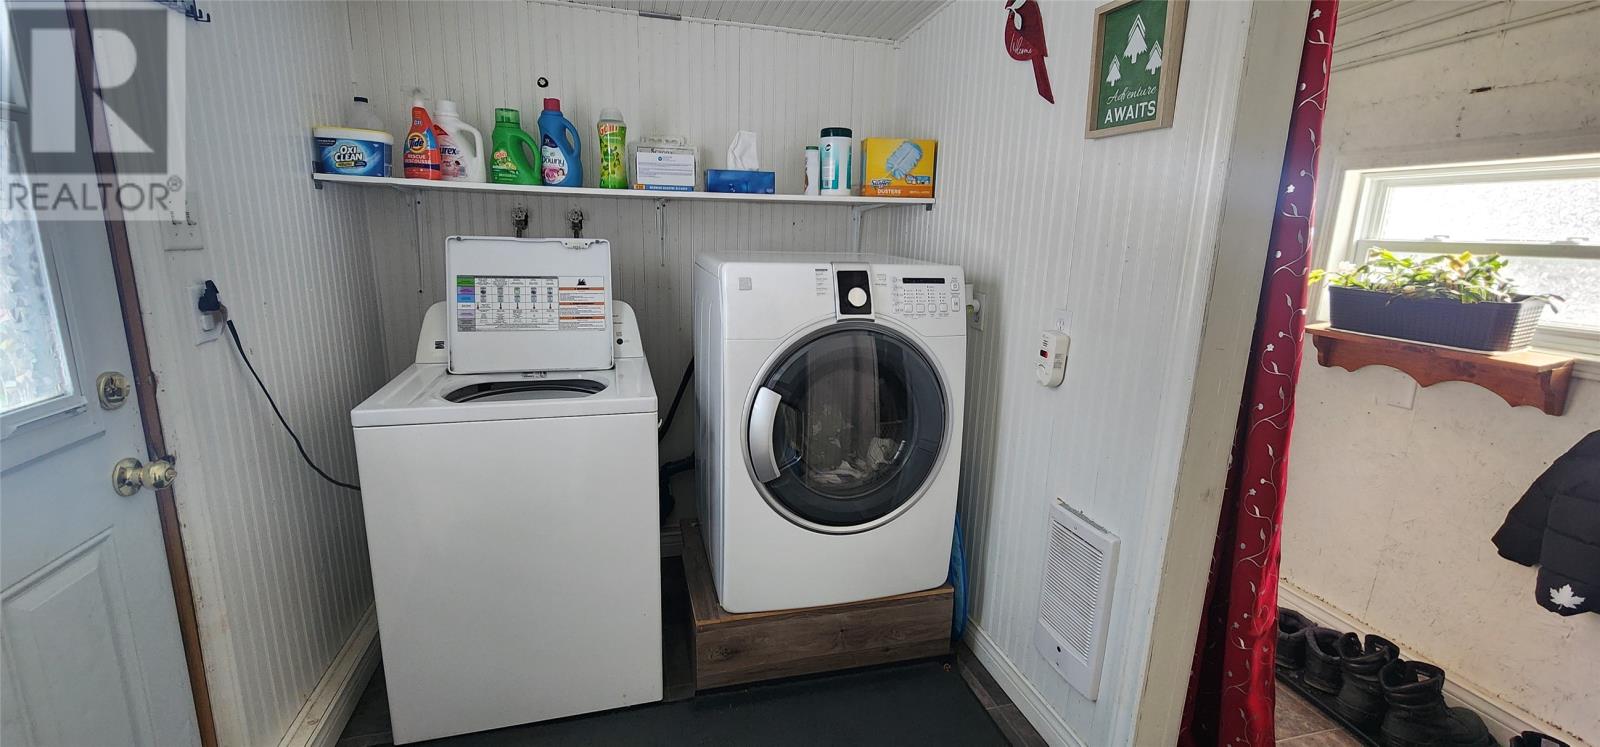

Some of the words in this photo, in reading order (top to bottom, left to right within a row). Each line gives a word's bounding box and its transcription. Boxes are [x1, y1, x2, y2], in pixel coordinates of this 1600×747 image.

[1106, 85, 1157, 105] Adventure
[1104, 100, 1157, 124] AWAITS
[408, 137, 424, 148] Tide
[440, 147, 457, 155] urex
[335, 153, 363, 162] CLEAN
